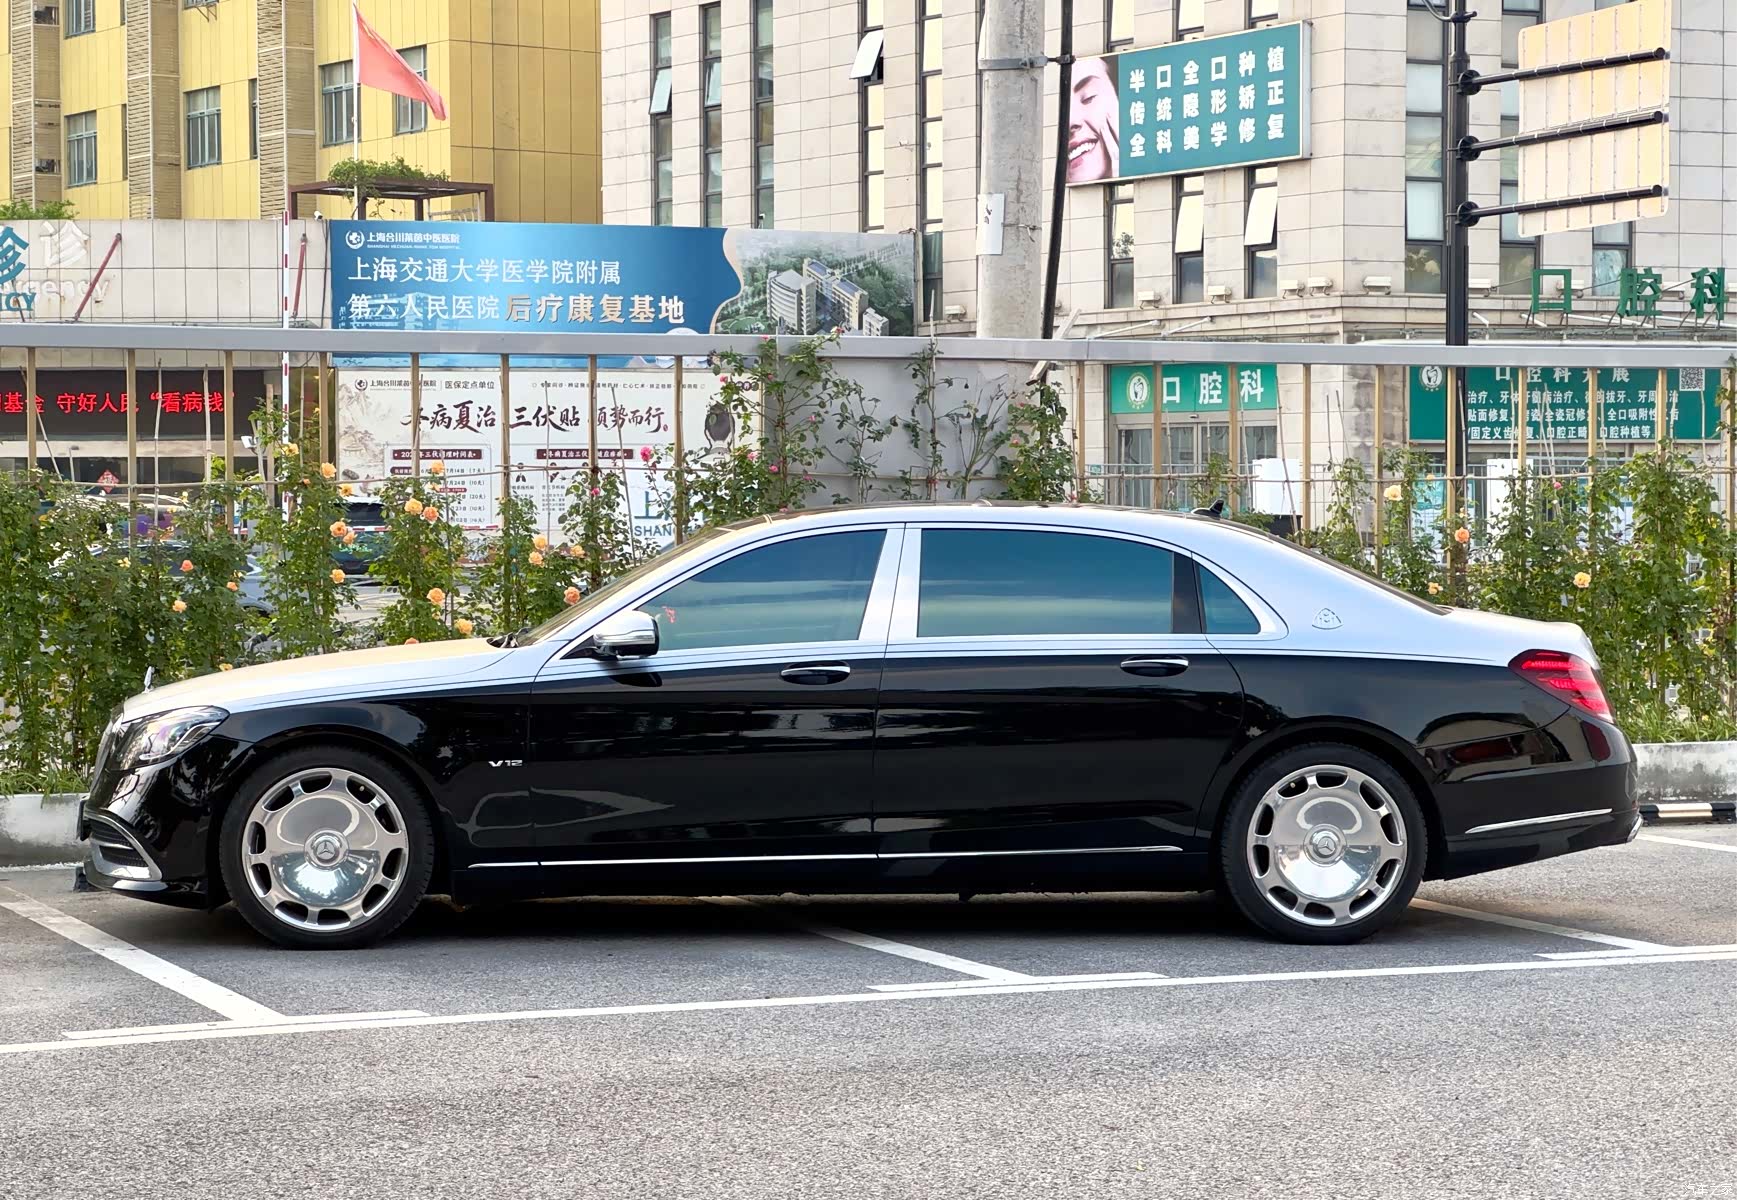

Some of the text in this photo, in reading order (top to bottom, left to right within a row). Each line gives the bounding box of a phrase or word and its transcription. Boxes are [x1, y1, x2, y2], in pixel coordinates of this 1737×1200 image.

[1129, 45, 1285, 94] 半口全口种植
[1129, 79, 1285, 126] 传统隐形矫正
[1129, 113, 1285, 158] 全科美学修复
[347, 256, 622, 285] 上海交通大学医学院附属
[348, 293, 686, 324] 第六人民医院 后疗康复基地
[1532, 267, 1729, 321] 口腔科
[445, 380, 495, 390] 医保定点单位
[1162, 369, 1264, 405] 口腔科
[0, 393, 45, 413] 基金
[509, 405, 581, 433] 三伏贴
[633, 525, 673, 537] SHAN
